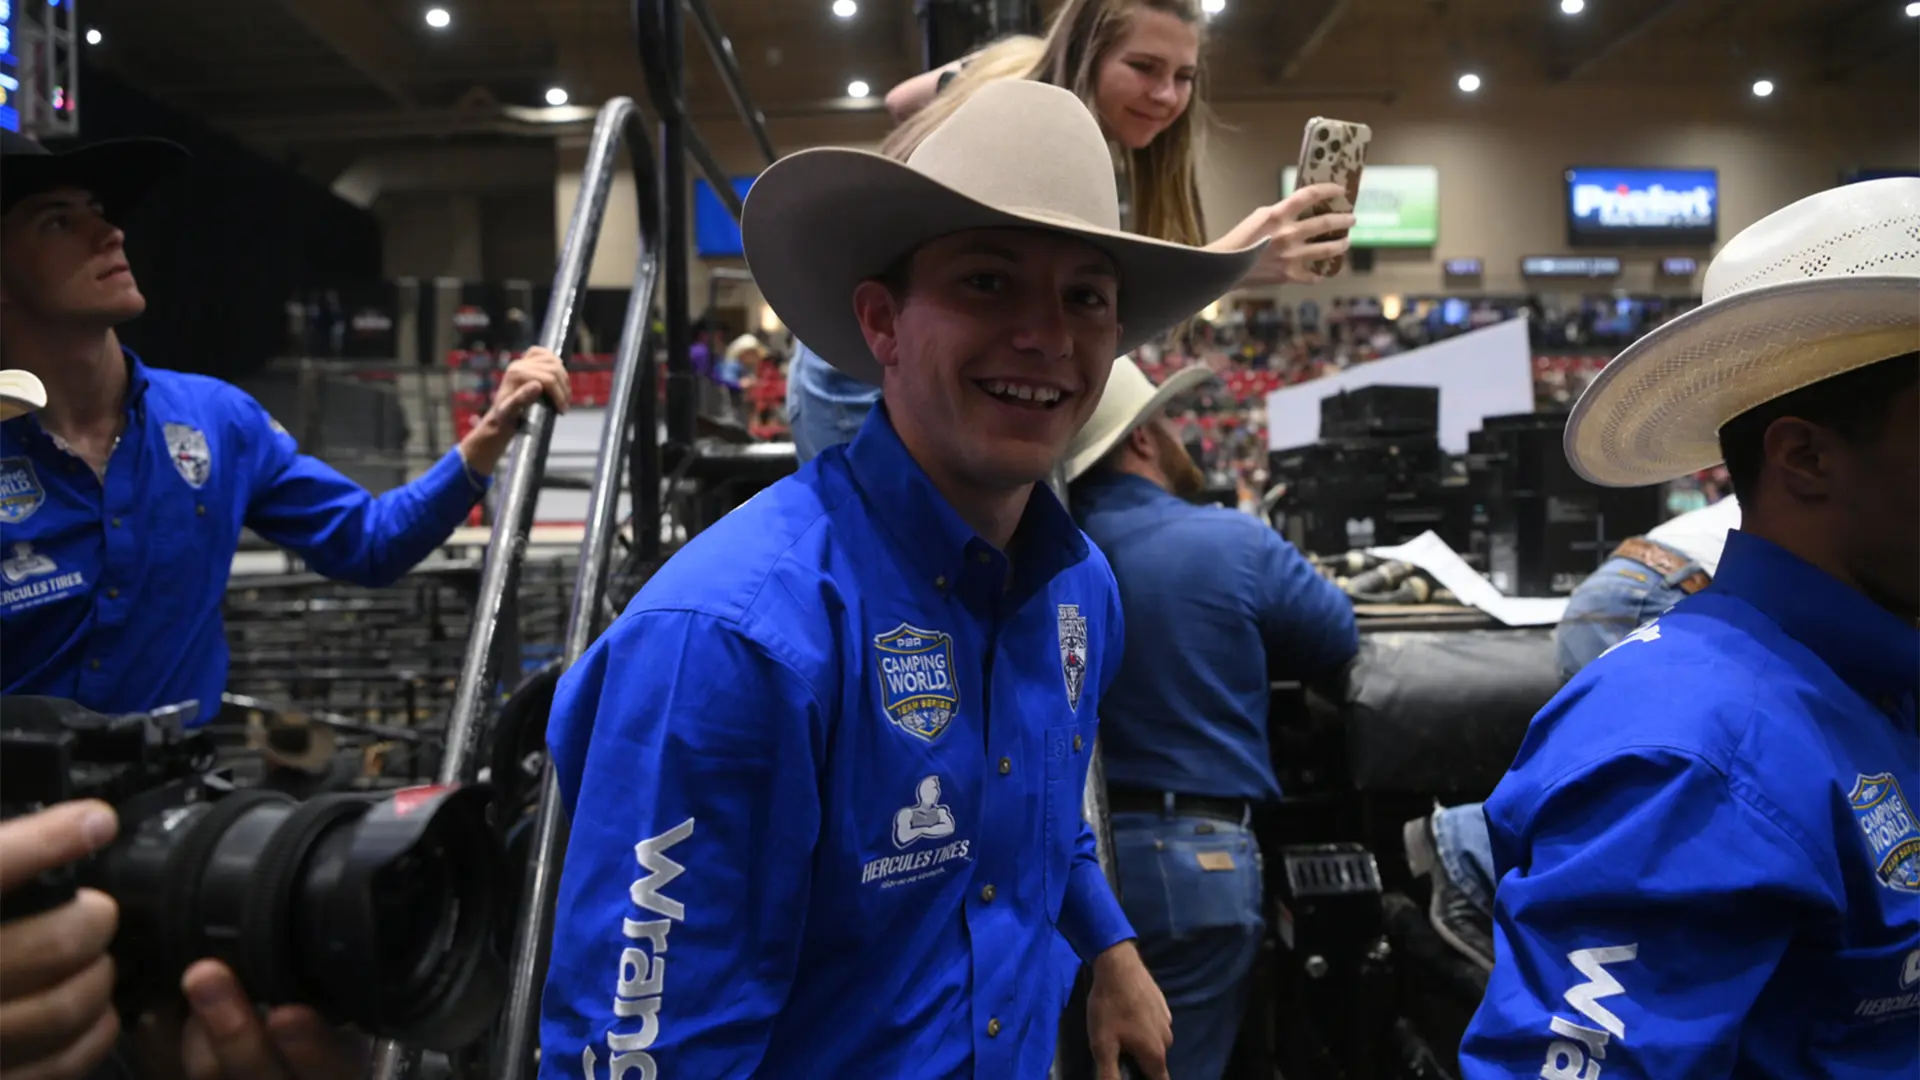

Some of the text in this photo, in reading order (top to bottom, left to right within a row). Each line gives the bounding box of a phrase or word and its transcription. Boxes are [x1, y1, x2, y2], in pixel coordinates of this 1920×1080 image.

[48, 571, 83, 592] TIRES
[882, 653, 946, 673] CAMPING
[886, 670, 947, 694] WORLD
[896, 701, 919, 716] TEAM
[1860, 794, 1903, 835] CAMPING
[1868, 812, 1910, 854] WORLD
[861, 849, 933, 884] HERCULES
[932, 839, 970, 865] TIRES
